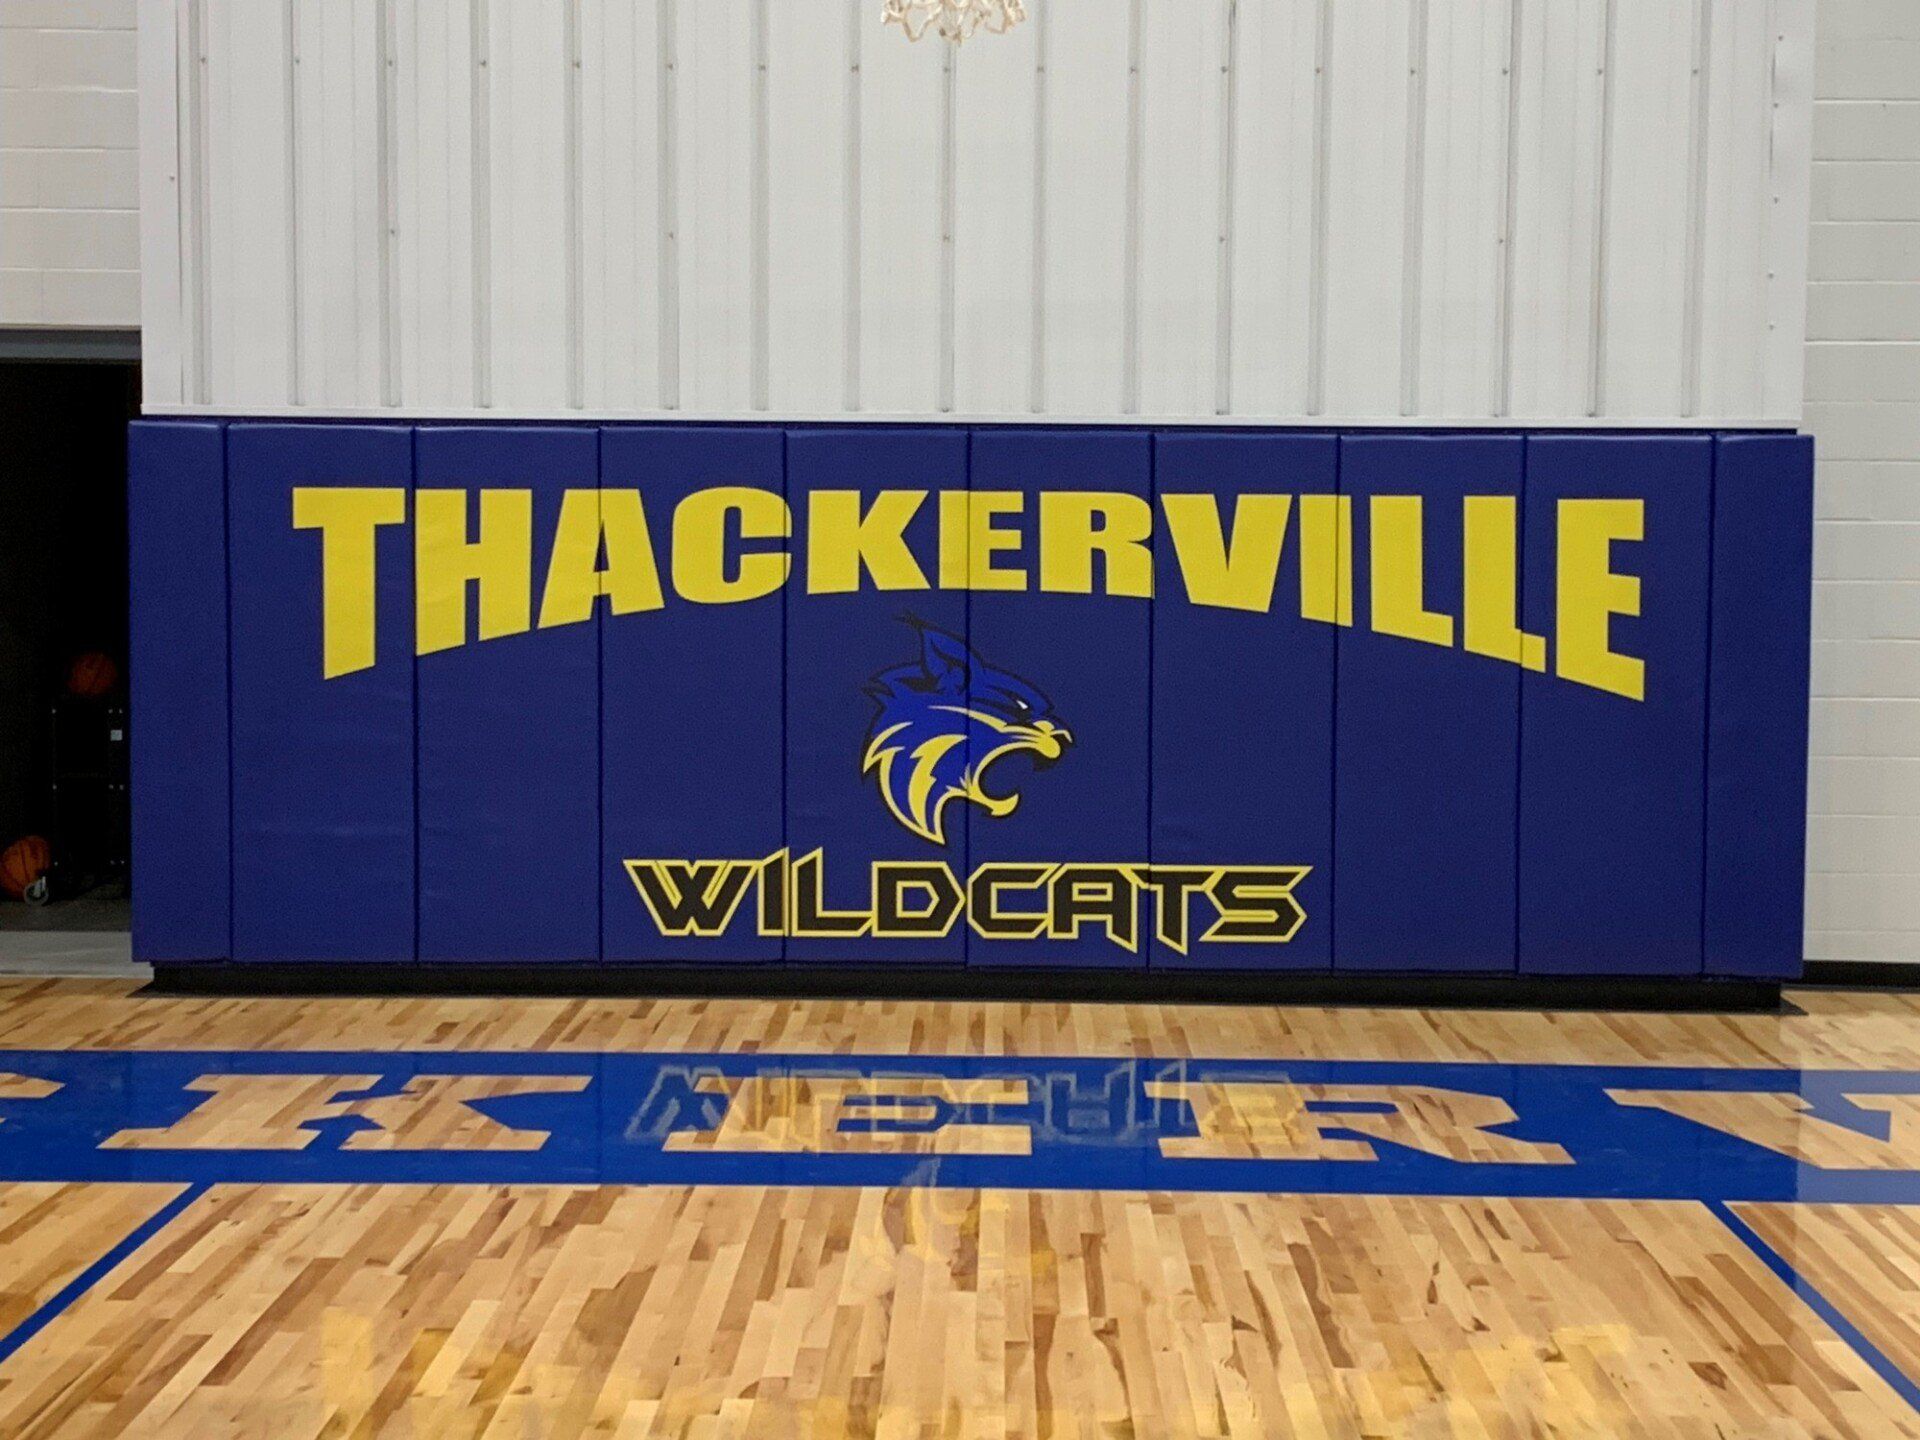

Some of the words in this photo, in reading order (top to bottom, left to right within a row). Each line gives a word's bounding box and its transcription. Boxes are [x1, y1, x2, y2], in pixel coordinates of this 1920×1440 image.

[291, 485, 1647, 702] THACKERVILLE
[622, 846, 1314, 956] WILDCATS
[0, 1071, 1920, 1171] KERV
